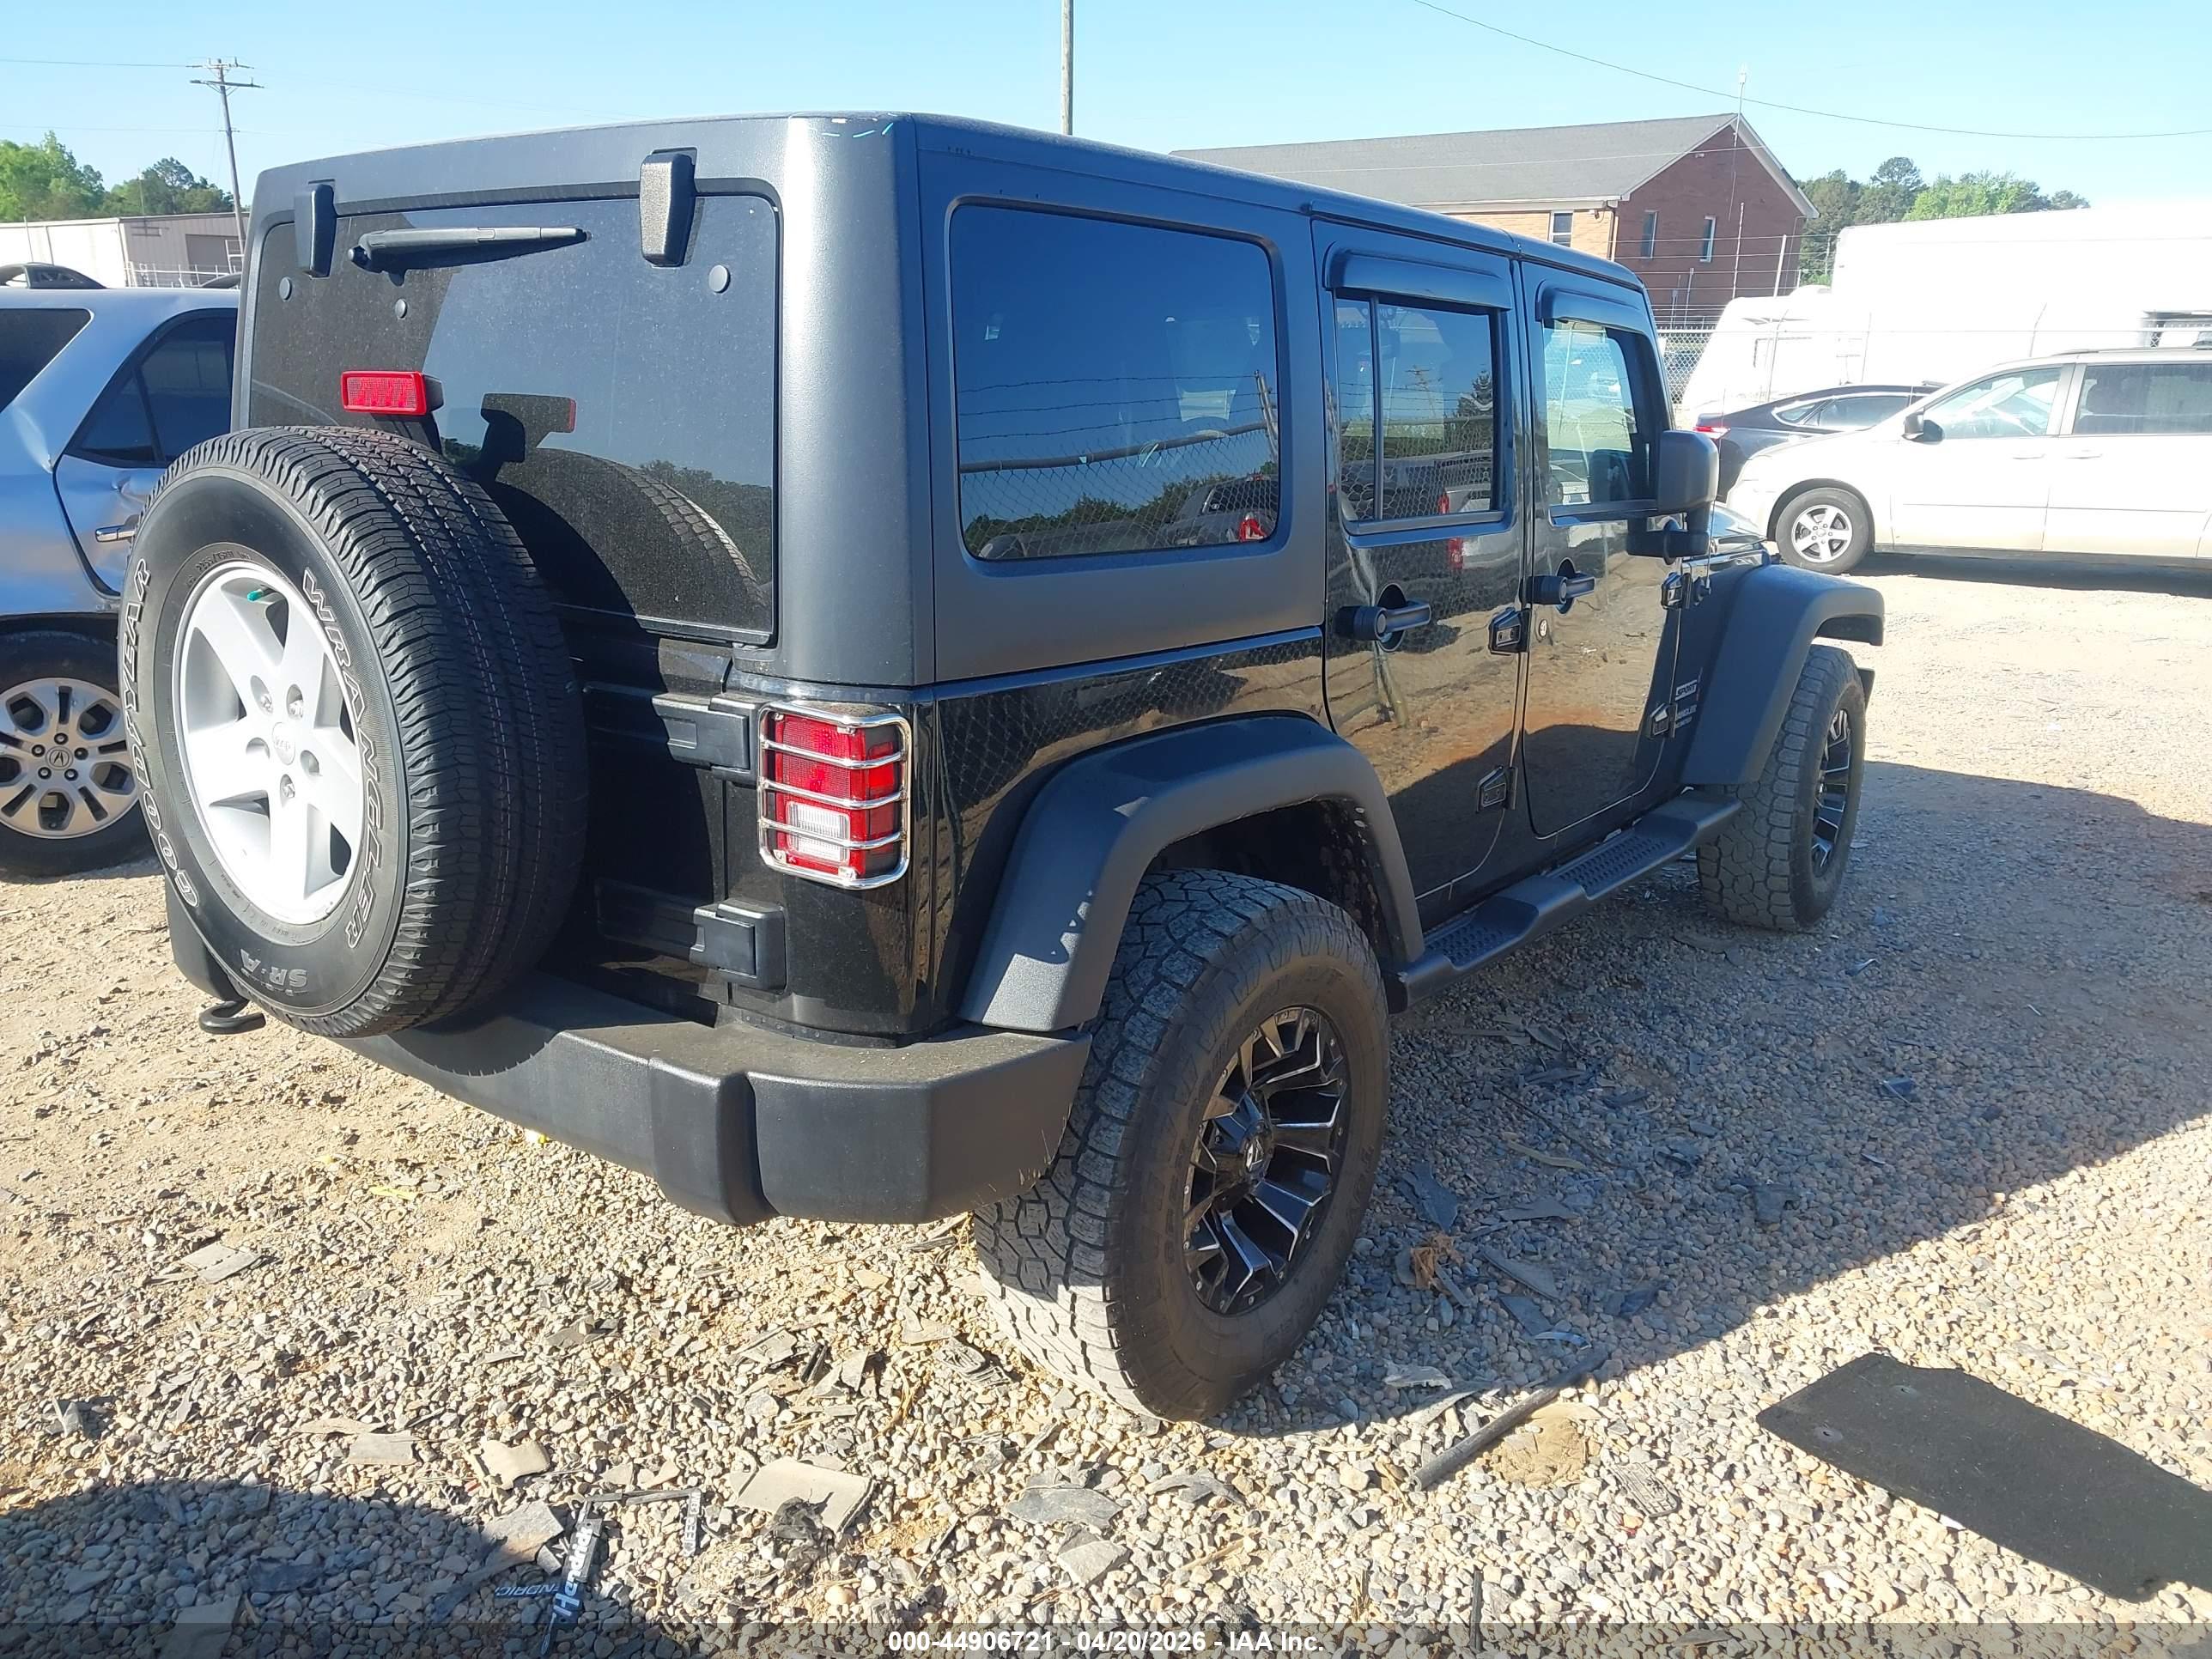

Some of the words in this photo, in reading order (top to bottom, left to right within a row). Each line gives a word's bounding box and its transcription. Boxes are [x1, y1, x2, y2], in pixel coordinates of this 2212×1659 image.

[123, 558, 199, 908] GOODYEAR
[302, 567, 384, 949] WRANGLER
[1676, 684, 1697, 696] SPORT
[555, 1527, 594, 1617] Hendrick
